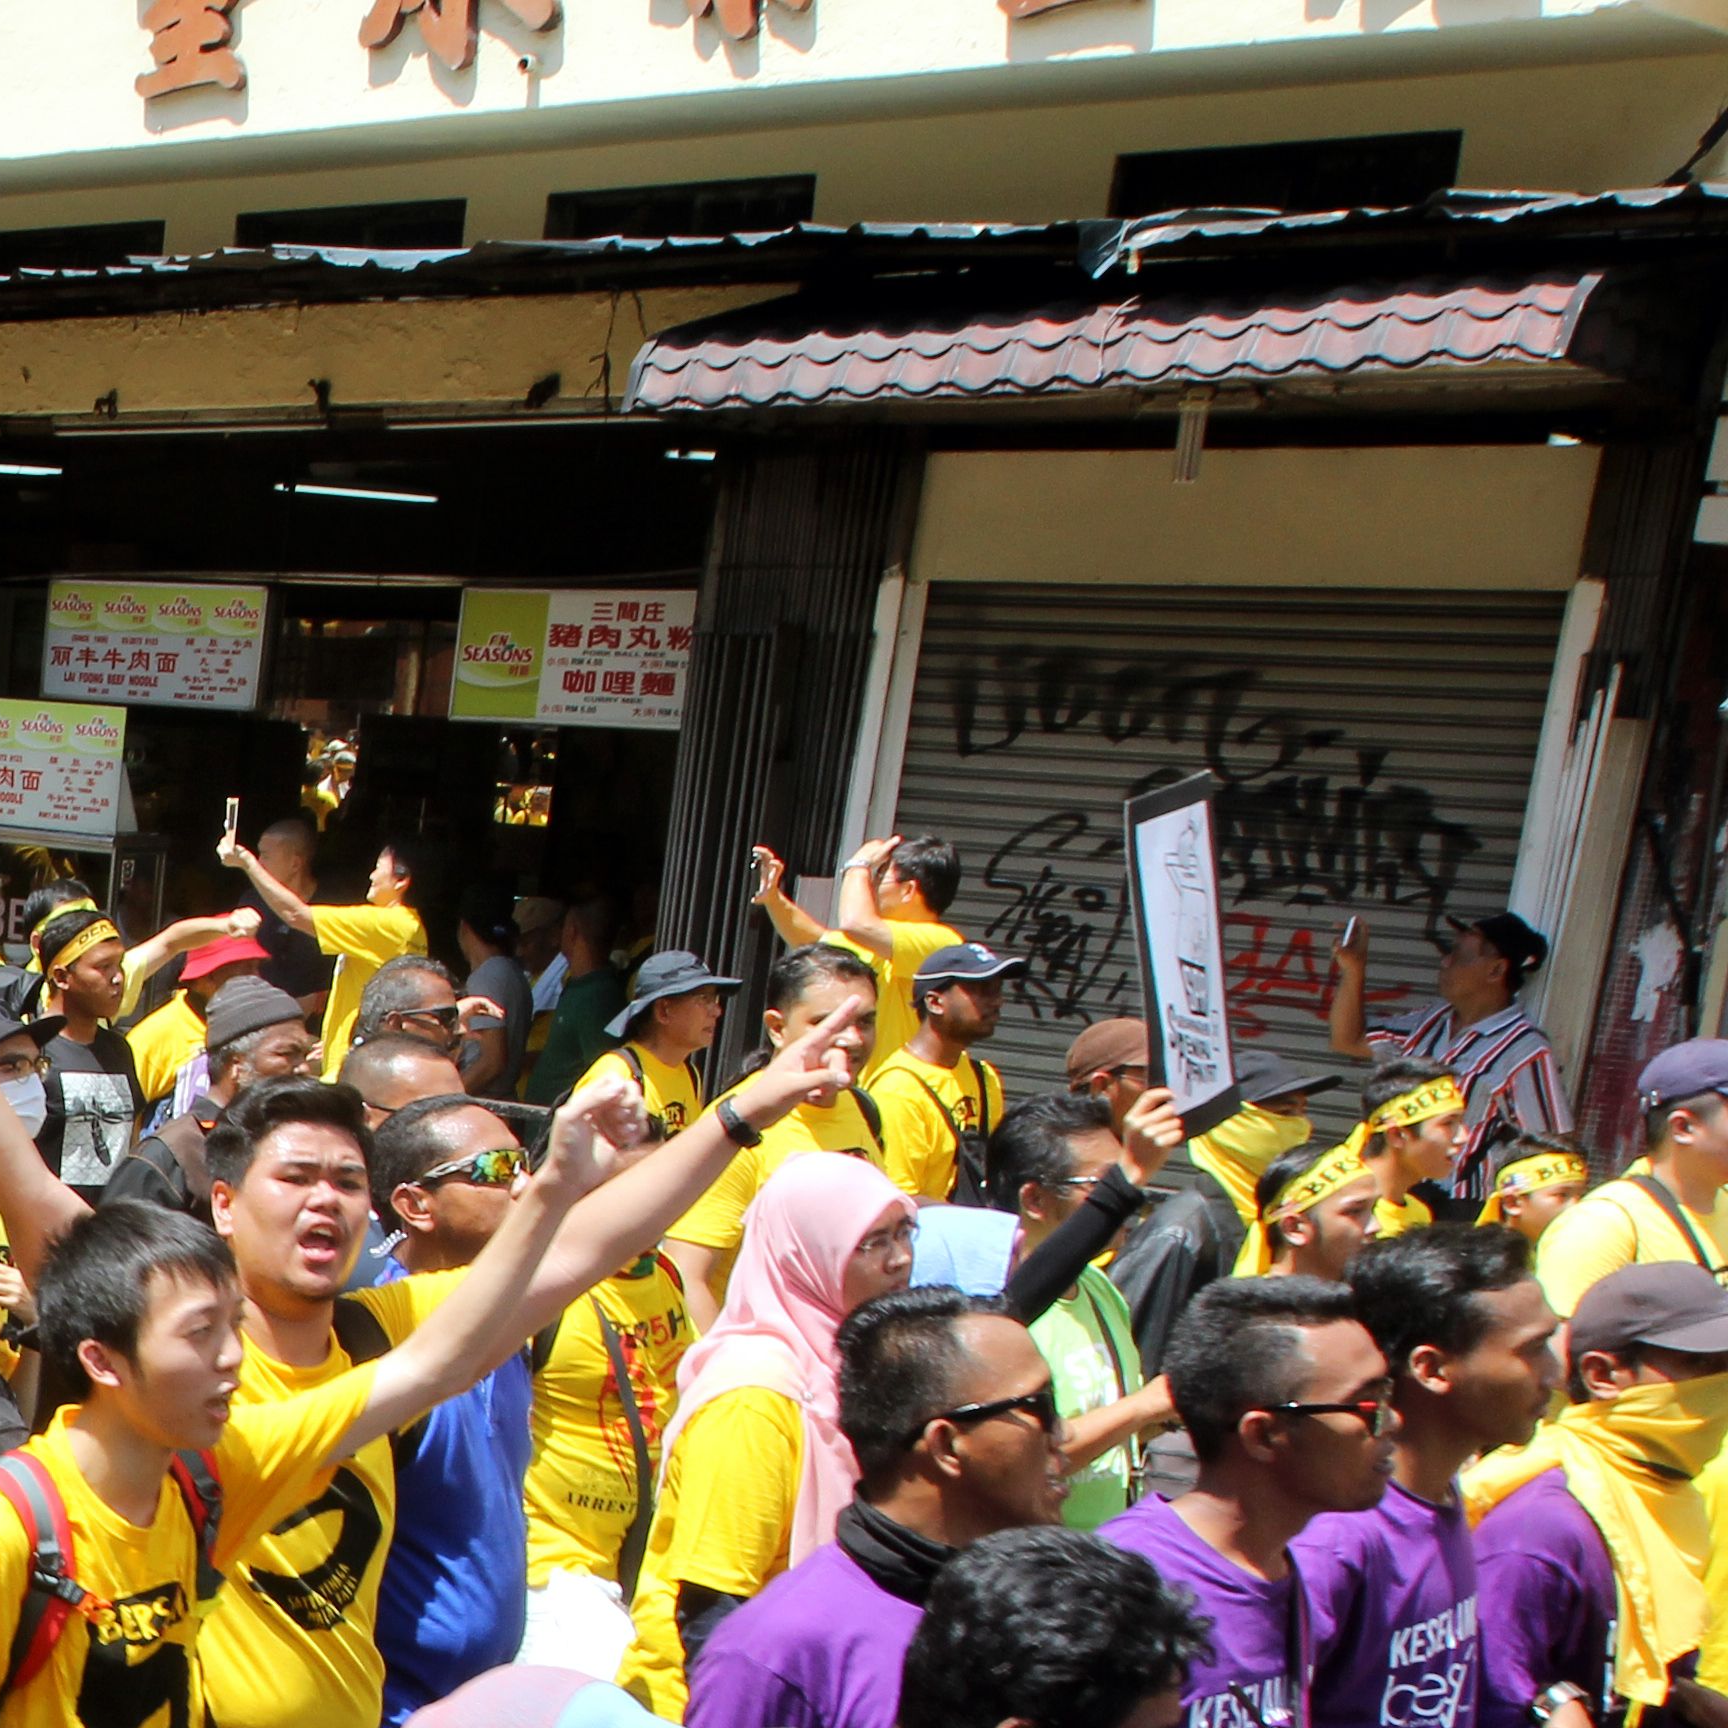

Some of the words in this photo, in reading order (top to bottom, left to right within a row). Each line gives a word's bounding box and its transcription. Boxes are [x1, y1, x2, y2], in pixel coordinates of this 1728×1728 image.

[51, 600, 93, 611] SEASONS
[103, 601, 147, 614] SEASONS
[158, 603, 202, 616] SEASONS
[213, 607, 259, 619] SEASONS
[462, 644, 534, 663] SEASONS
[22, 719, 64, 733] SEASONS
[75, 724, 119, 738] SEASONS
